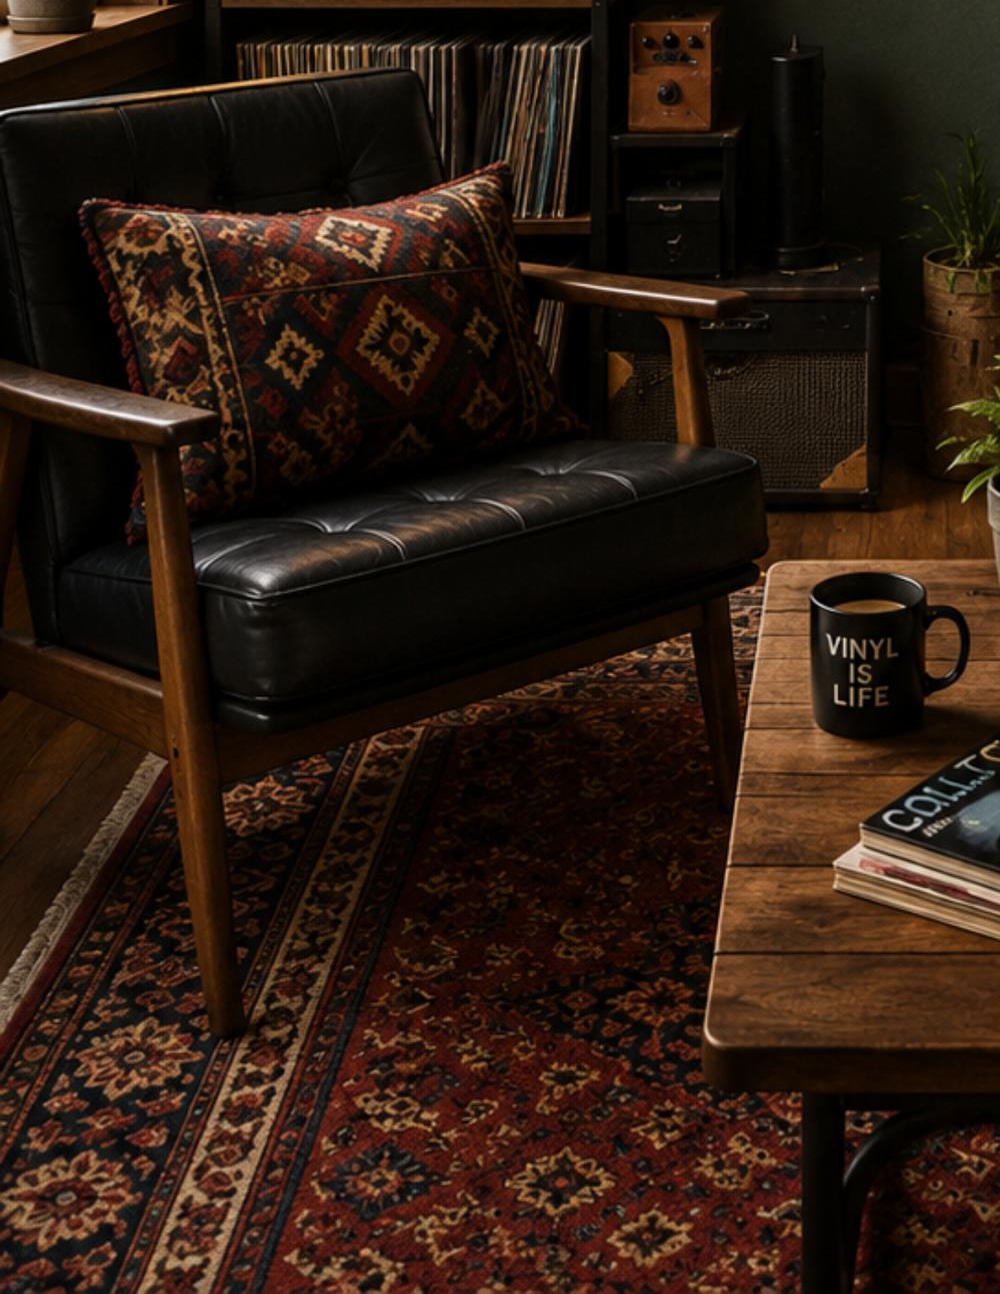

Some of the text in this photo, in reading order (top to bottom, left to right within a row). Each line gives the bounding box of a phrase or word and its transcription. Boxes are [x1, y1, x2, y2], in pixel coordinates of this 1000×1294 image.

[825, 632, 899, 660] VINYL
[849, 662, 872, 684] IS
[833, 683, 889, 708] LIFE
